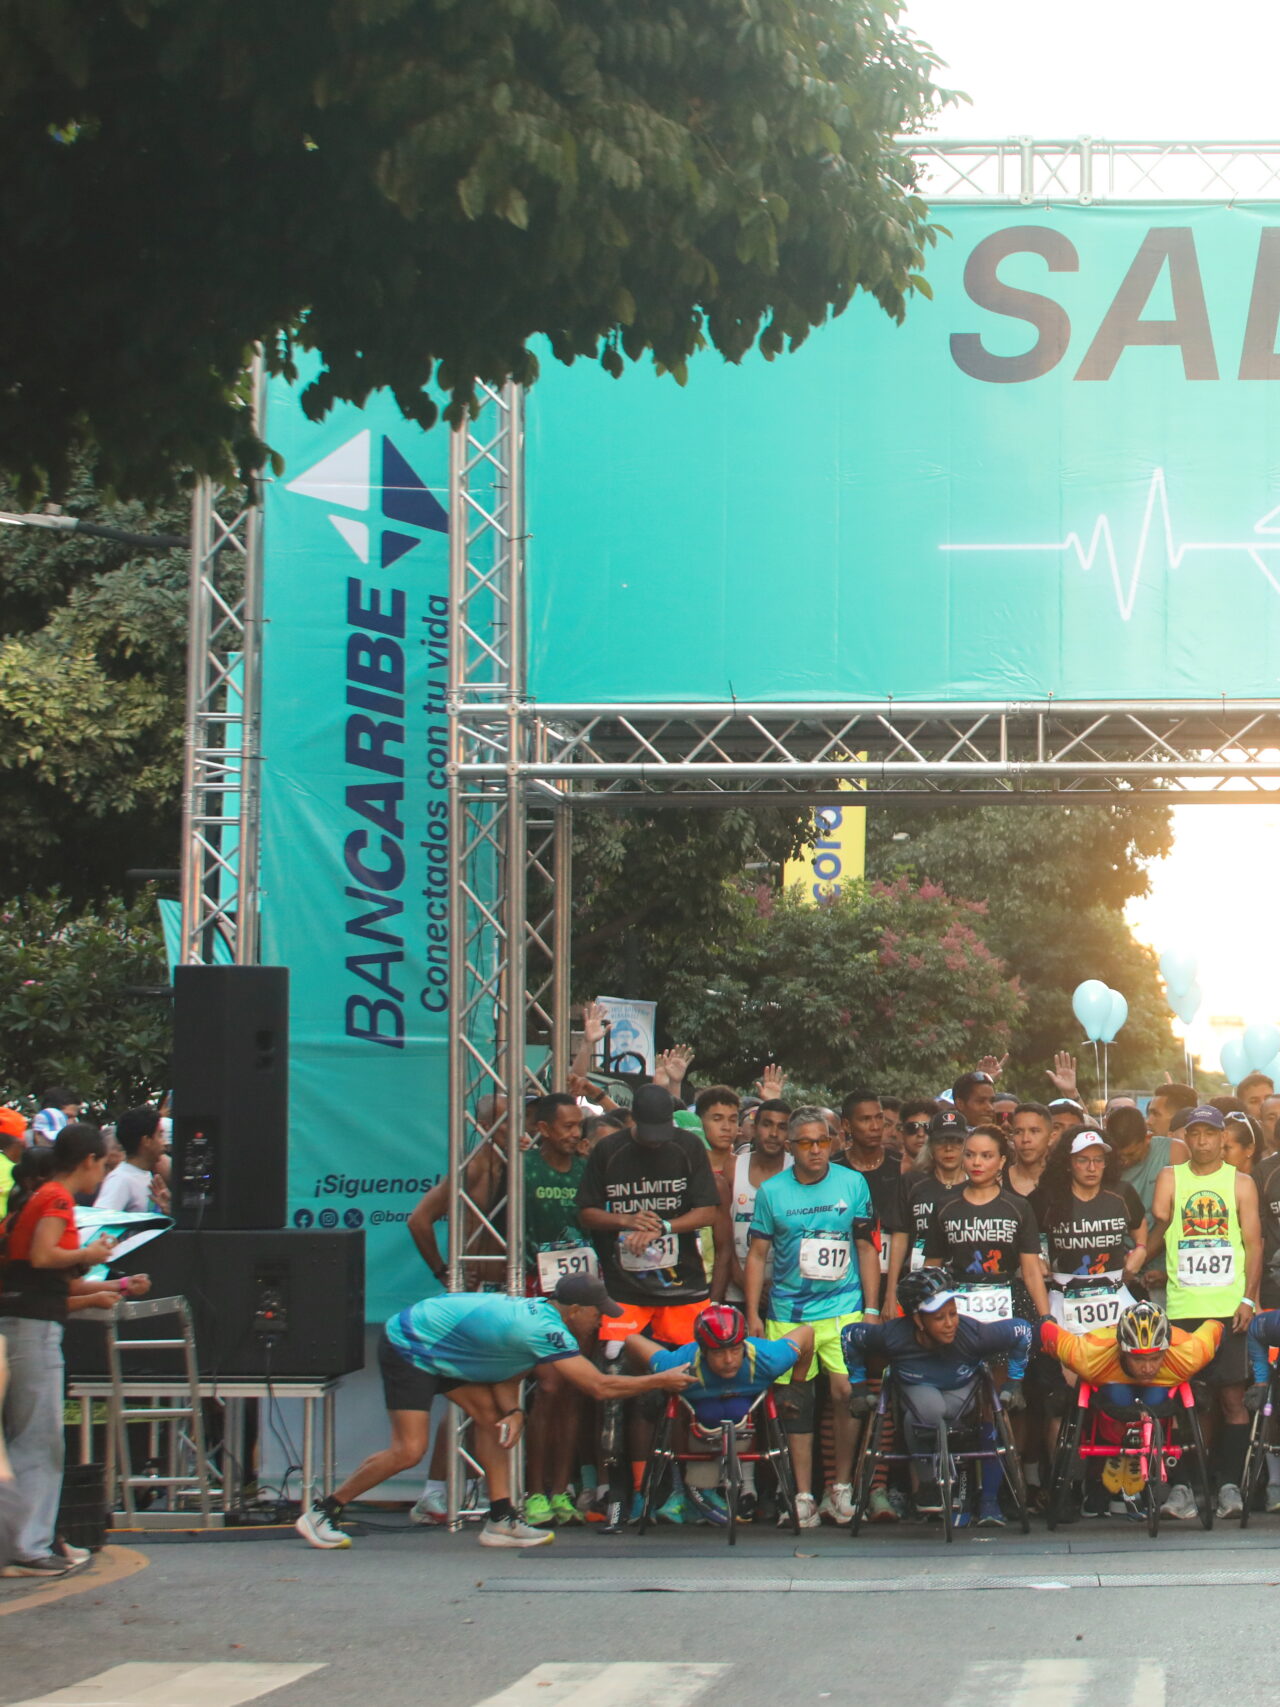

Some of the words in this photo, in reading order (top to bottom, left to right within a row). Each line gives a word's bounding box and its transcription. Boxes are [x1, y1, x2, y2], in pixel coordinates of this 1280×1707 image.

[421, 594, 450, 669] vida
[422, 680, 450, 715] tu
[427, 726, 450, 789] con
[344, 576, 406, 1049] BANCARIBE
[420, 800, 450, 1013] Conectados
[606, 1183, 630, 1198] SIN
[633, 1177, 687, 1195] LÍMITES
[785, 1204, 834, 1217] BANCARIBE
[913, 1202, 933, 1216] SIN
[965, 1216, 1018, 1232] LÍMITES
[1073, 1218, 1126, 1233] LÍMITES
[947, 1230, 1014, 1244] RUNNERS
[1054, 1234, 1122, 1249] RUNNERS
[557, 1255, 590, 1276] 591
[818, 1247, 847, 1268] 817
[1187, 1255, 1232, 1274] 1487
[966, 1296, 1010, 1313] 1332
[1075, 1301, 1119, 1324] 1307
